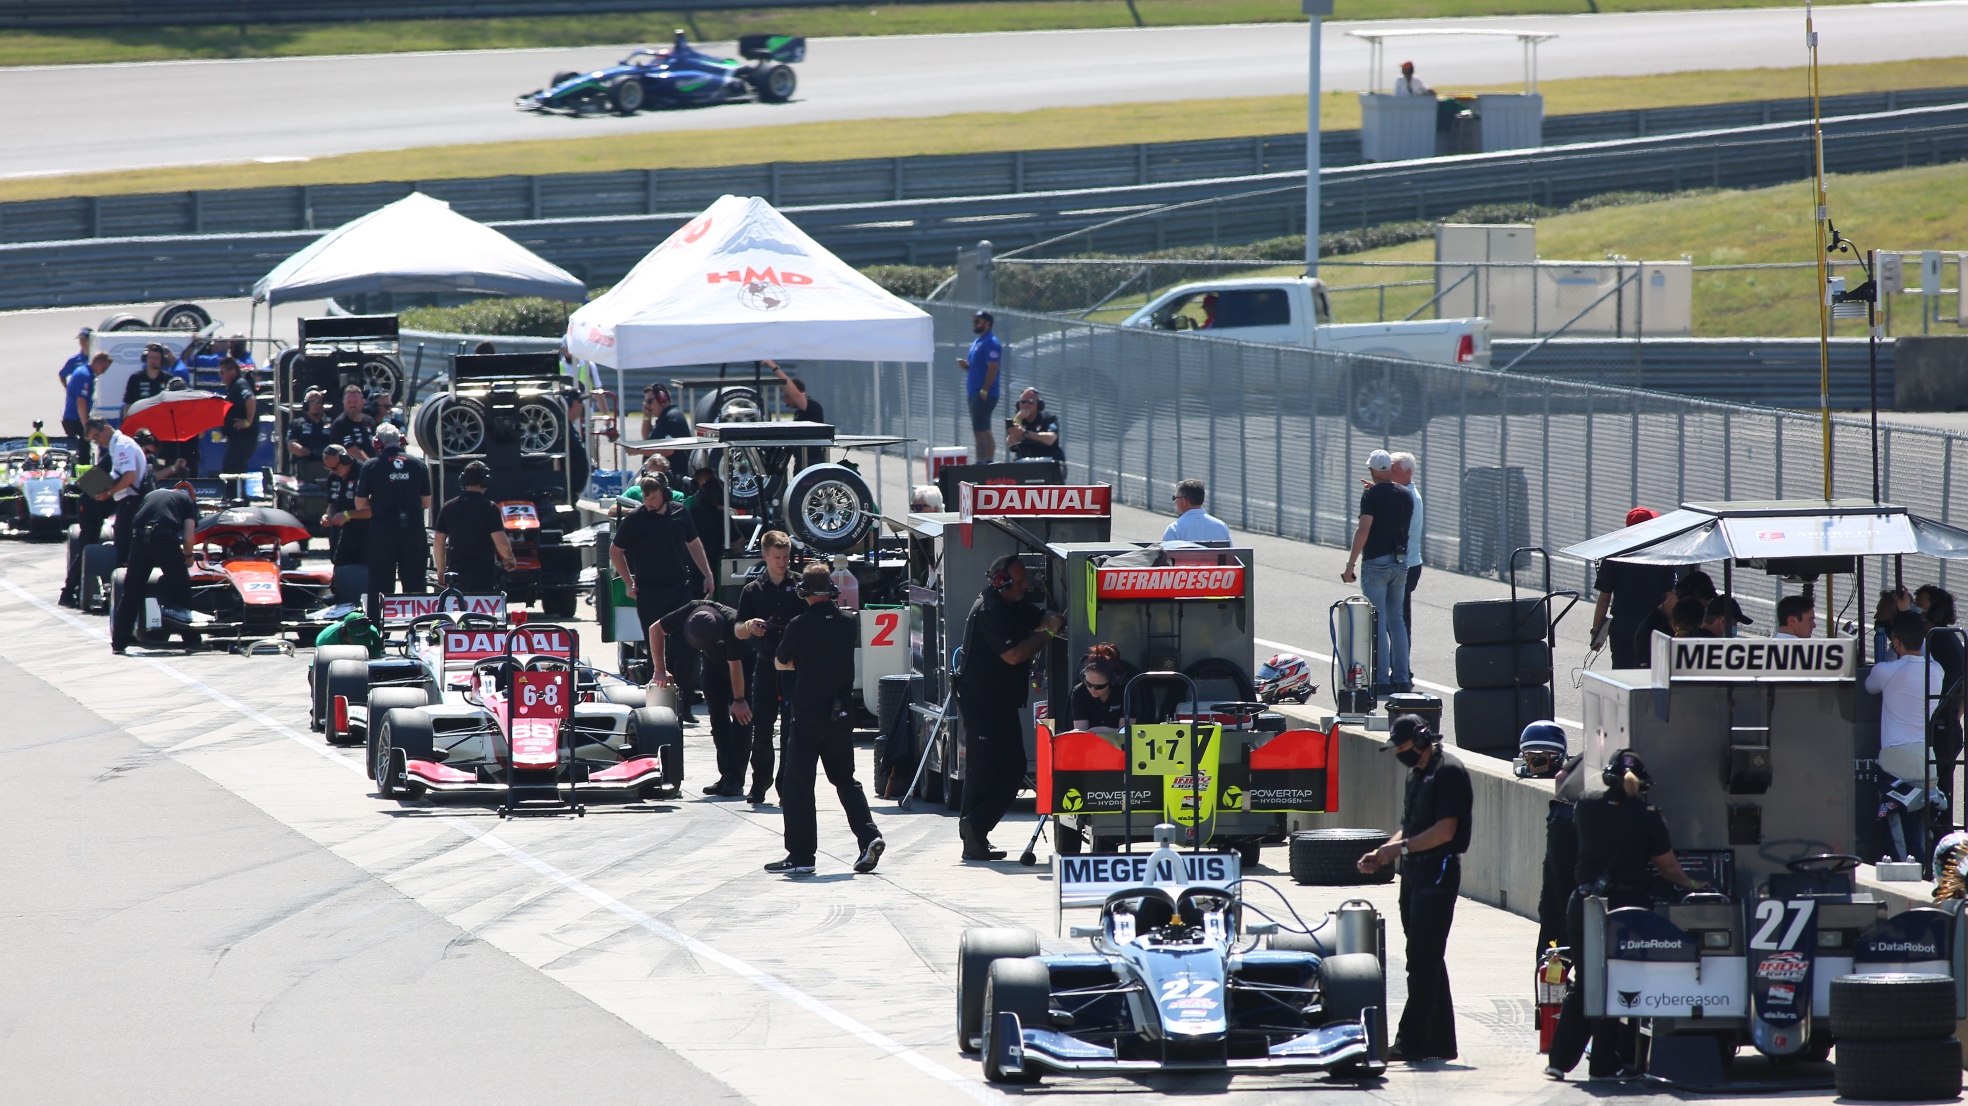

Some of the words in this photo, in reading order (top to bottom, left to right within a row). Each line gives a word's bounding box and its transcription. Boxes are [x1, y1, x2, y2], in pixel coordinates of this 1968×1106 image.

[706, 265, 813, 287] HMD
[507, 506, 530, 514] 24
[976, 489, 1101, 510] DANIAL
[1102, 570, 1236, 591] DEFRANCESCO
[870, 613, 899, 646] 2
[1675, 643, 1844, 671] MEGENNIS
[1250, 789, 1313, 798] POWERTAP
[1749, 899, 1815, 951] 27
[1626, 940, 1682, 950] DataRobot
[1878, 942, 1936, 953] DataRobot
[1760, 962, 1809, 972] INDY
[1159, 978, 1221, 1004] 27
[1645, 992, 1730, 1009] cybereason
